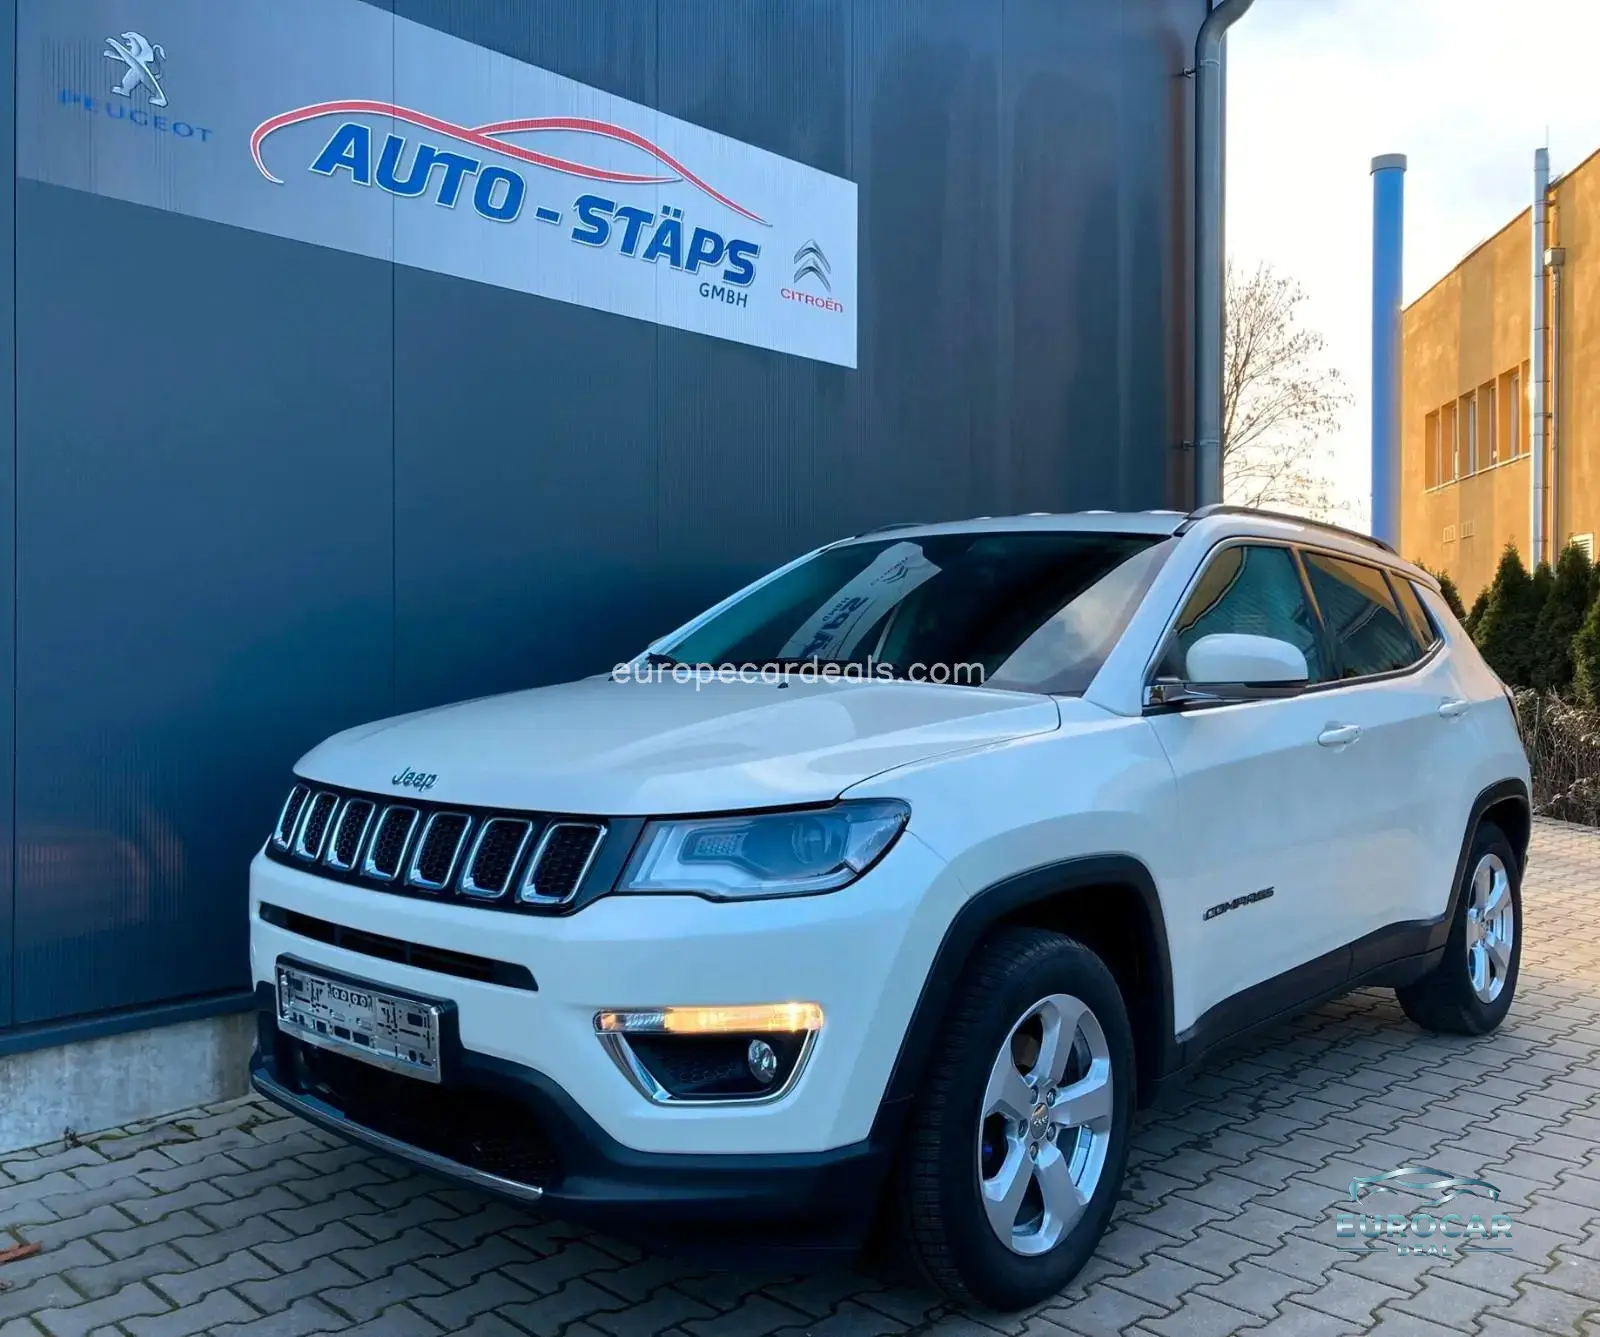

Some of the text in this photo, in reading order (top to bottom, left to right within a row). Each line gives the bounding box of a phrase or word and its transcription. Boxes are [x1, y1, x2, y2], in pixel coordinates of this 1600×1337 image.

[309, 122, 526, 222] AUTO
[571, 193, 759, 287] STÄPS
[699, 282, 748, 308] GMBH
[392, 767, 438, 792] Jeep
